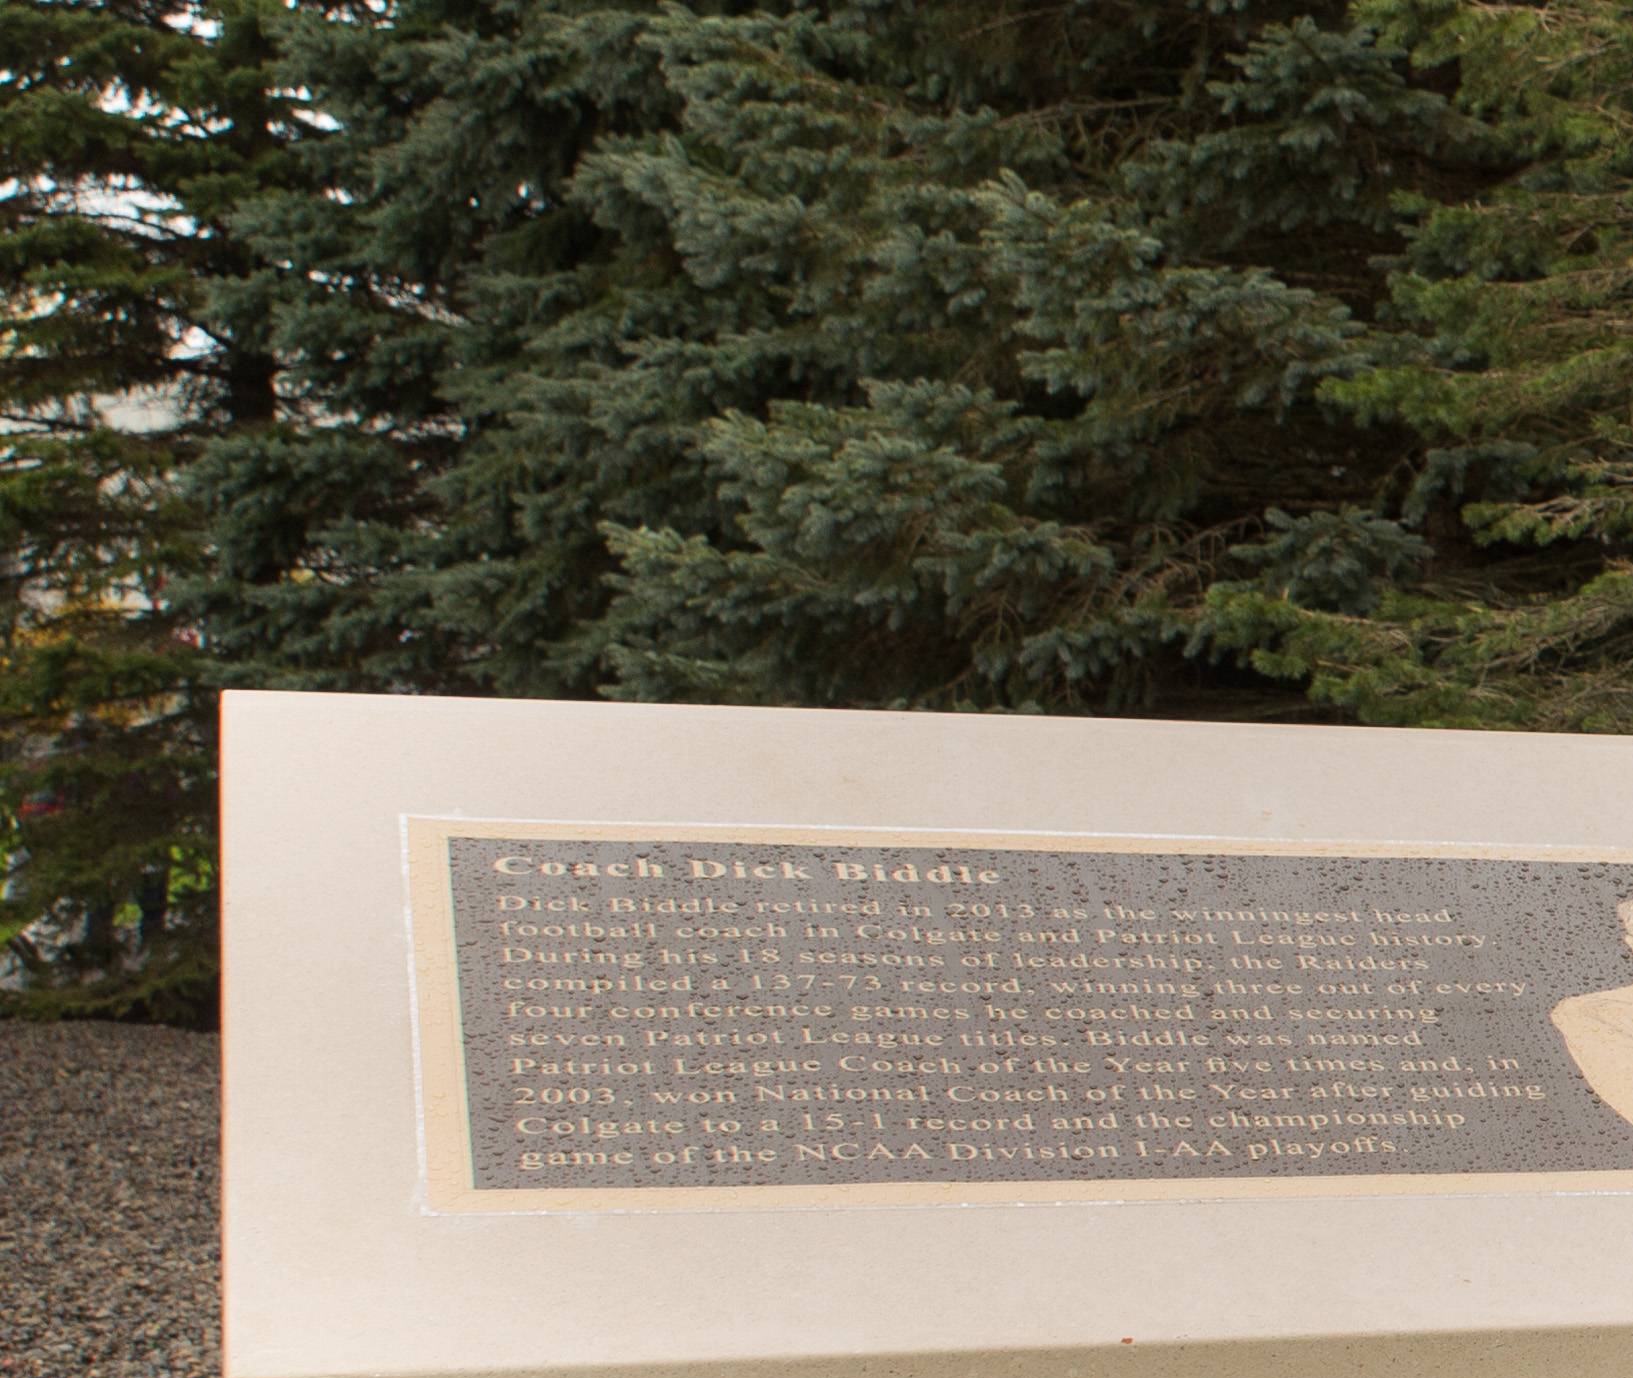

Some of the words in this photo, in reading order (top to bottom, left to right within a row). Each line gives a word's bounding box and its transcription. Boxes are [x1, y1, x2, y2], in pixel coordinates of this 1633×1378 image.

[493, 857, 664, 878] Coach
[690, 860, 812, 879] Dick
[832, 862, 1000, 883] Biddle
[499, 896, 589, 912] Dick
[609, 898, 738, 913] Biddle
[754, 899, 880, 915] retired
[900, 902, 932, 917] in
[950, 903, 1034, 918] 2013
[1053, 908, 1088, 919] as
[1103, 906, 1156, 920] the
[1171, 907, 1362, 925] winningest
[1374, 909, 1453, 923] head
[500, 921, 657, 938] football
[676, 924, 787, 938] coach
[805, 923, 839, 938] in
[857, 924, 1000, 945] Colgate
[1018, 928, 1080, 943] and
[1097, 929, 1217, 944] Patriot
[1231, 931, 1357, 948] League
[1371, 932, 1498, 948] history.
[502, 948, 643, 968] During
[660, 950, 718, 964] his
[738, 950, 780, 964] 18
[799, 953, 945, 967] seasons
[961, 952, 1000, 968] of
[1012, 953, 1216, 973] leadership,
[1230, 955, 1283, 970] the
[1298, 955, 1429, 970] Raiders
[504, 975, 692, 994] compiled
[711, 979, 730, 990] a
[751, 974, 883, 991] 137-73
[901, 978, 1035, 996] record,
[1051, 979, 1200, 998] winning
[1215, 980, 1303, 995] three
[1318, 982, 1373, 995] out
[1387, 980, 1423, 995] of
[1436, 982, 1527, 997] every
[508, 1001, 592, 1018] four
[611, 1002, 832, 1019] conference
[851, 1004, 970, 1020] games
[985, 1004, 1028, 1020] he
[1045, 1005, 1195, 1021] coached
[1210, 1006, 1275, 1021] and
[1289, 1006, 1440, 1024] securing
[510, 1032, 625, 1046] seven
[646, 1029, 784, 1046] Patriot
[801, 1028, 945, 1048] League
[960, 1030, 1070, 1047] titles.
[1086, 1031, 1209, 1047] Biddle
[1226, 1033, 1292, 1047] was
[1307, 1031, 1423, 1047] named
[511, 1058, 655, 1075] Patriot
[675, 1057, 822, 1077] League
[839, 1056, 961, 1074] Coach
[979, 1057, 1020, 1074] of
[1033, 1057, 1092, 1074] the
[1105, 1058, 1190, 1074] Year
[1204, 1057, 1273, 1073] five
[1288, 1057, 1386, 1073] times
[1402, 1056, 1474, 1073] and,
[1488, 1055, 1520, 1071] in
[513, 1087, 632, 1107] 2003,
[653, 1091, 737, 1104] won
[755, 1085, 929, 1102] National
[948, 1085, 1069, 1102] Coach
[1086, 1085, 1126, 1102] of
[1140, 1084, 1198, 1101] the
[1210, 1084, 1295, 1101] Year
[1311, 1081, 1394, 1099] after
[1411, 1082, 1547, 1101] guiding
[517, 1117, 685, 1138] Colgate
[704, 1117, 741, 1134] to
[761, 1119, 780, 1132] a
[803, 1113, 884, 1131] 15-1
[907, 1114, 1036, 1132] record
[1052, 1112, 1120, 1131] and
[1135, 1112, 1195, 1130] the
[1209, 1109, 1466, 1130] championship
[520, 1150, 635, 1170] game
[653, 1147, 700, 1165] of
[715, 1145, 779, 1163] the
[793, 1142, 934, 1161] NCAA
[948, 1142, 1120, 1160] Division
[1136, 1140, 1233, 1158] I-AA
[1249, 1136, 1408, 1159] playoffs.
